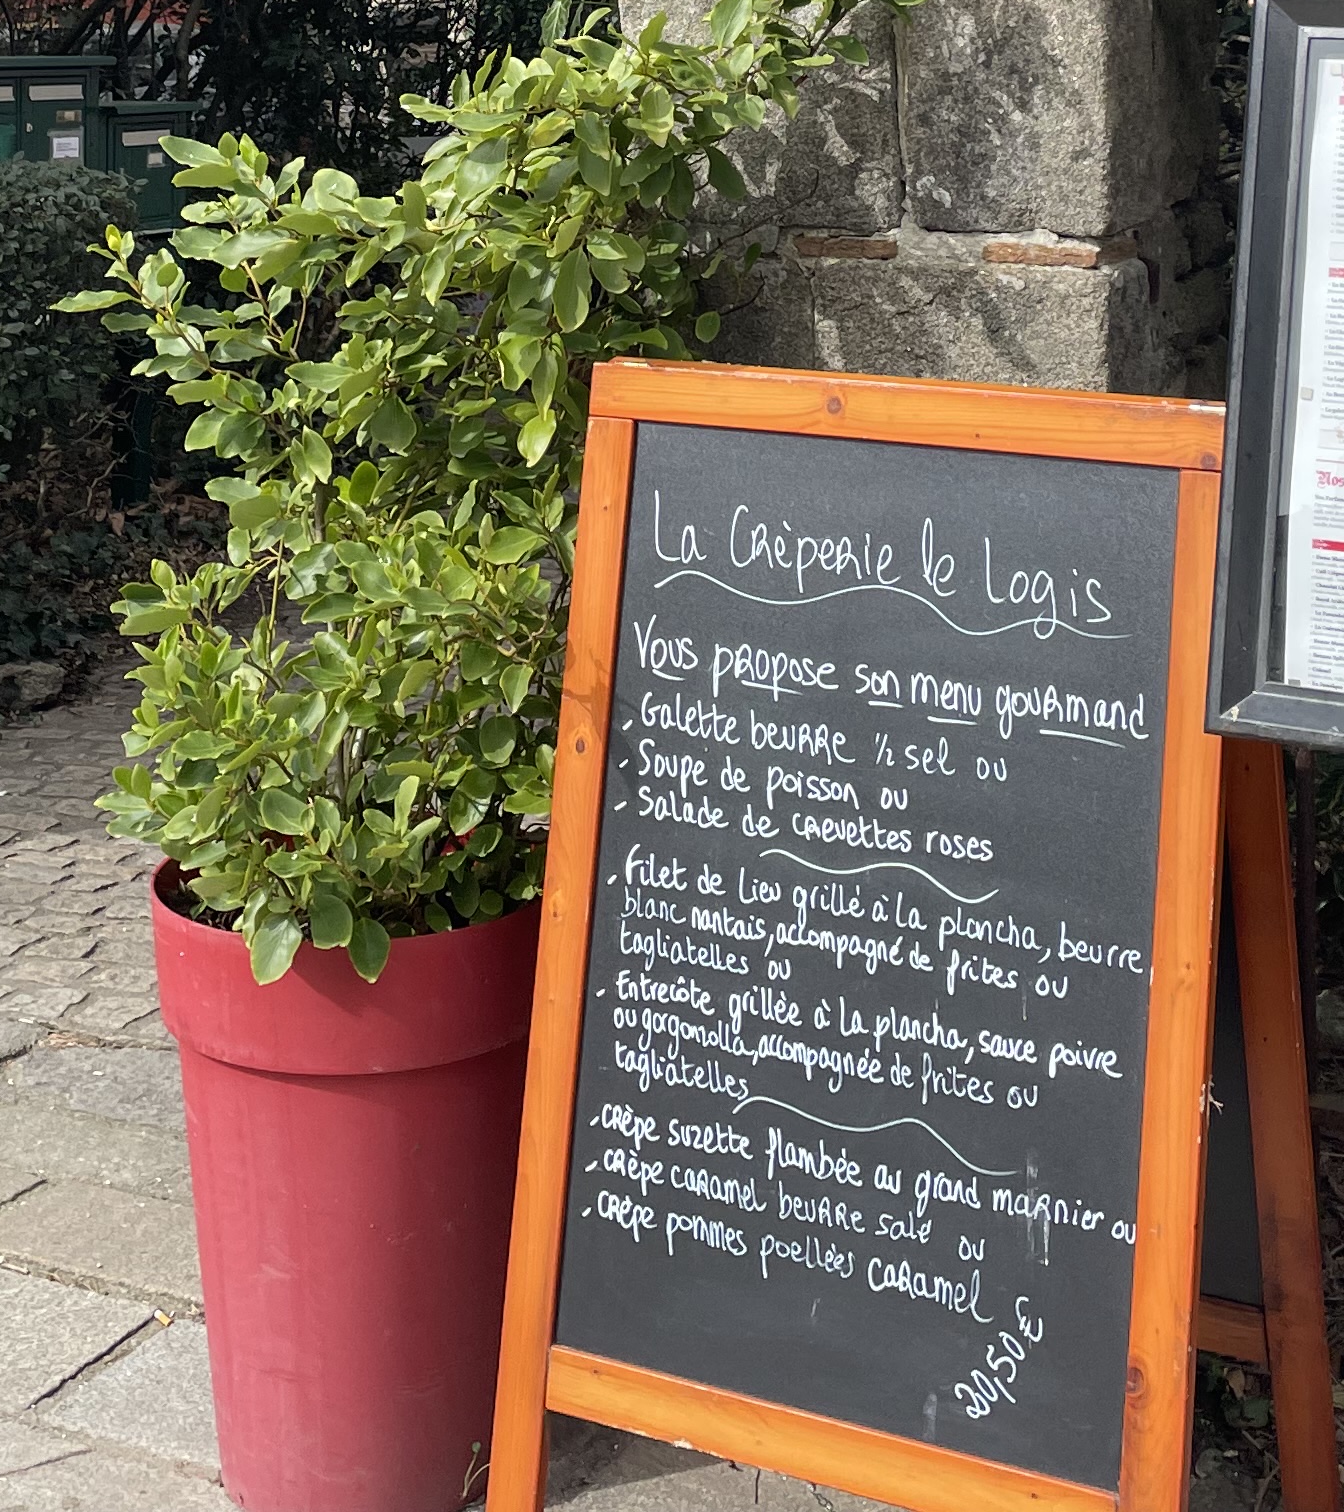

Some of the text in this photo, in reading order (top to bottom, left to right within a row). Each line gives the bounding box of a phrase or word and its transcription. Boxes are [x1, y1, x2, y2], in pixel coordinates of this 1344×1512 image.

[654, 489, 707, 565] La
[633, 613, 1150, 740] Vous propose son menu gourmand
[637, 737, 908, 811] Soupe de poisson ou
[640, 691, 741, 746] Galette
[750, 708, 856, 766] beurre
[904, 736, 957, 776] sel
[975, 756, 1007, 782] ou
[637, 785, 995, 862] Salade de crevettes roses
[619, 919, 792, 981] tagliatelles ou
[620, 884, 687, 925] blanc
[909, 940, 934, 972] de
[946, 948, 1019, 996] frites
[1034, 973, 1069, 1000] ou
[696, 863, 727, 896] de
[871, 893, 890, 923] à
[1057, 920, 1144, 974] beurre
[612, 1006, 638, 1029] ou
[889, 1051, 915, 1089] de
[921, 1051, 995, 1106] frites
[1005, 1084, 1039, 1110] ou
[614, 1039, 751, 1101] tagliatelles
[615, 969, 716, 1016] Entrecôte
[813, 998, 832, 1030] à
[978, 1029, 1038, 1064] sauce
[1048, 1040, 1124, 1079] poivre
[667, 1118, 754, 1160] suzette
[873, 1163, 902, 1195] au
[914, 1169, 982, 1218] grand
[991, 1188, 1105, 1231] marnier
[1110, 1219, 1136, 1245] ou
[669, 1163, 768, 1213] caramel
[777, 1179, 866, 1234] beurre
[957, 1234, 986, 1262] ou
[665, 1211, 748, 1257] pommes
[866, 1256, 995, 1324] caramel
